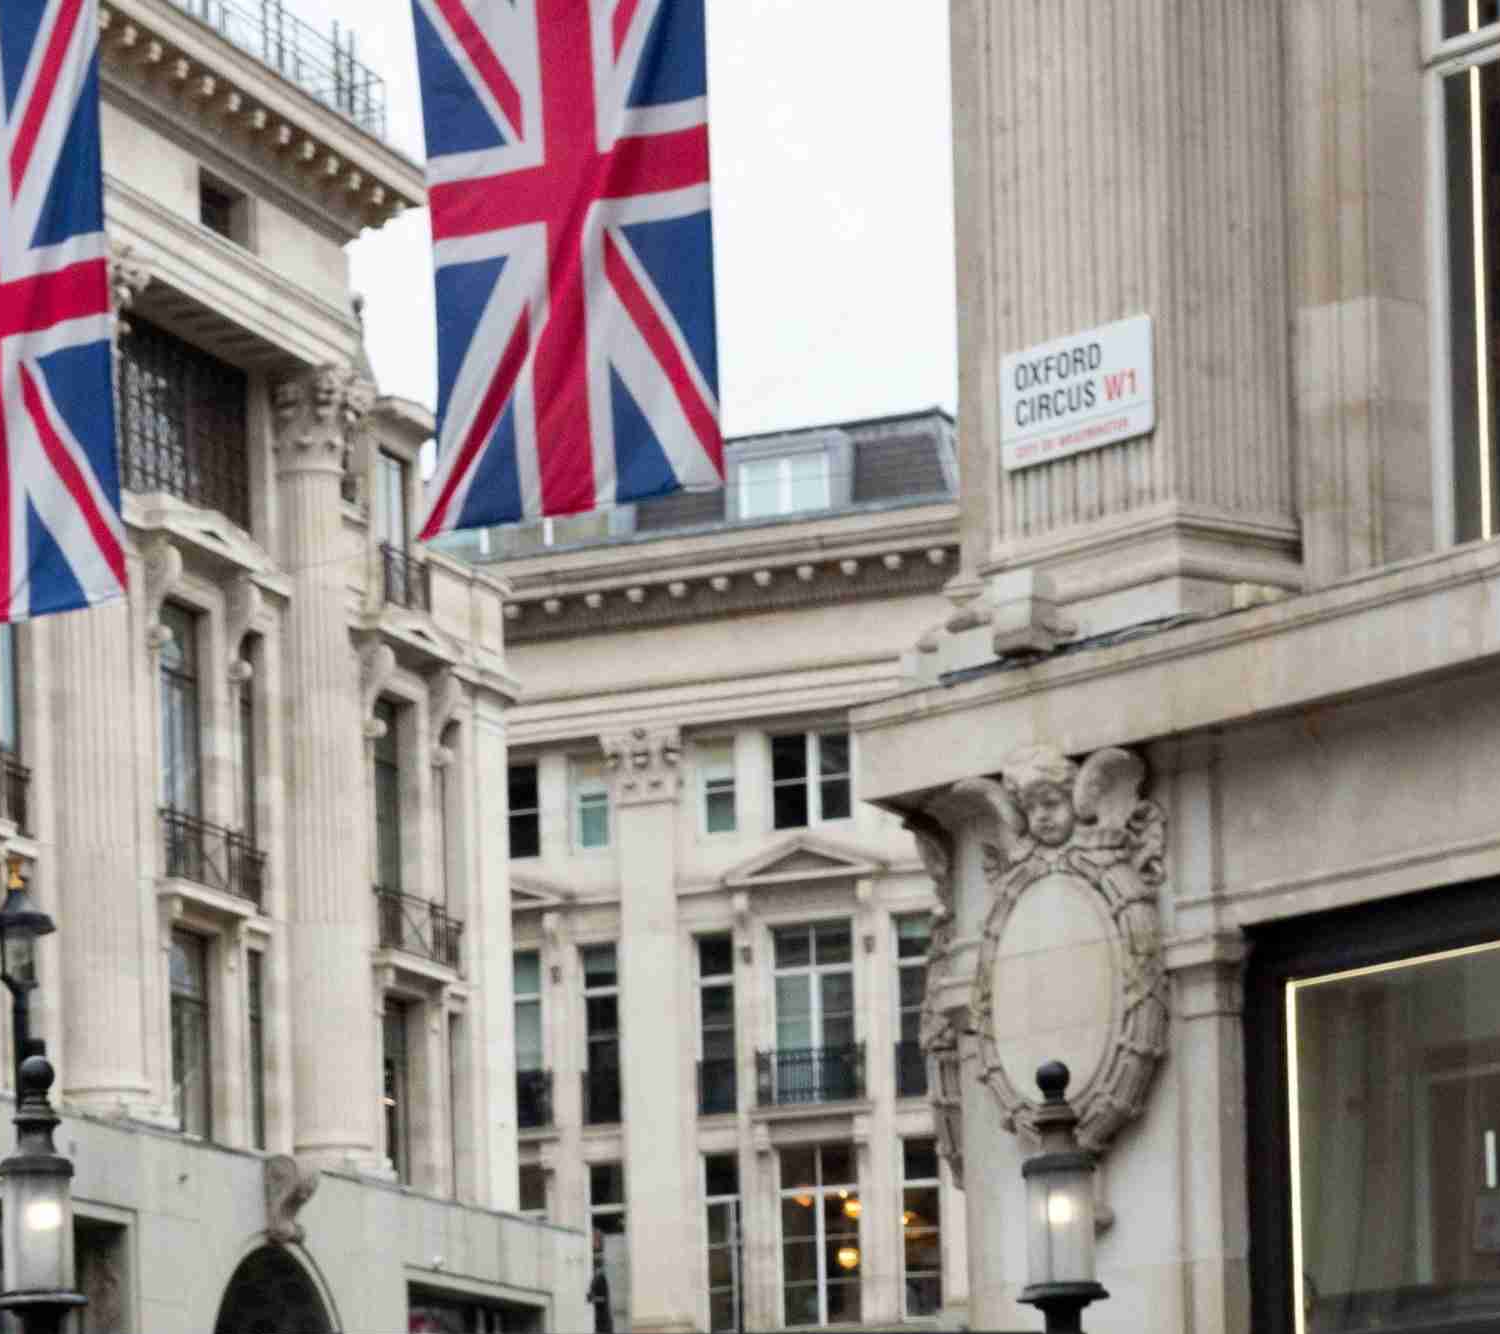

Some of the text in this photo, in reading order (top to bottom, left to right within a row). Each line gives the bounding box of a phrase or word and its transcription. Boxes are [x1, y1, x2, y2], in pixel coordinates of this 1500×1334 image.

[1014, 343, 1102, 391] OXFORD
[1015, 367, 1137, 426] CIRCUS W1
